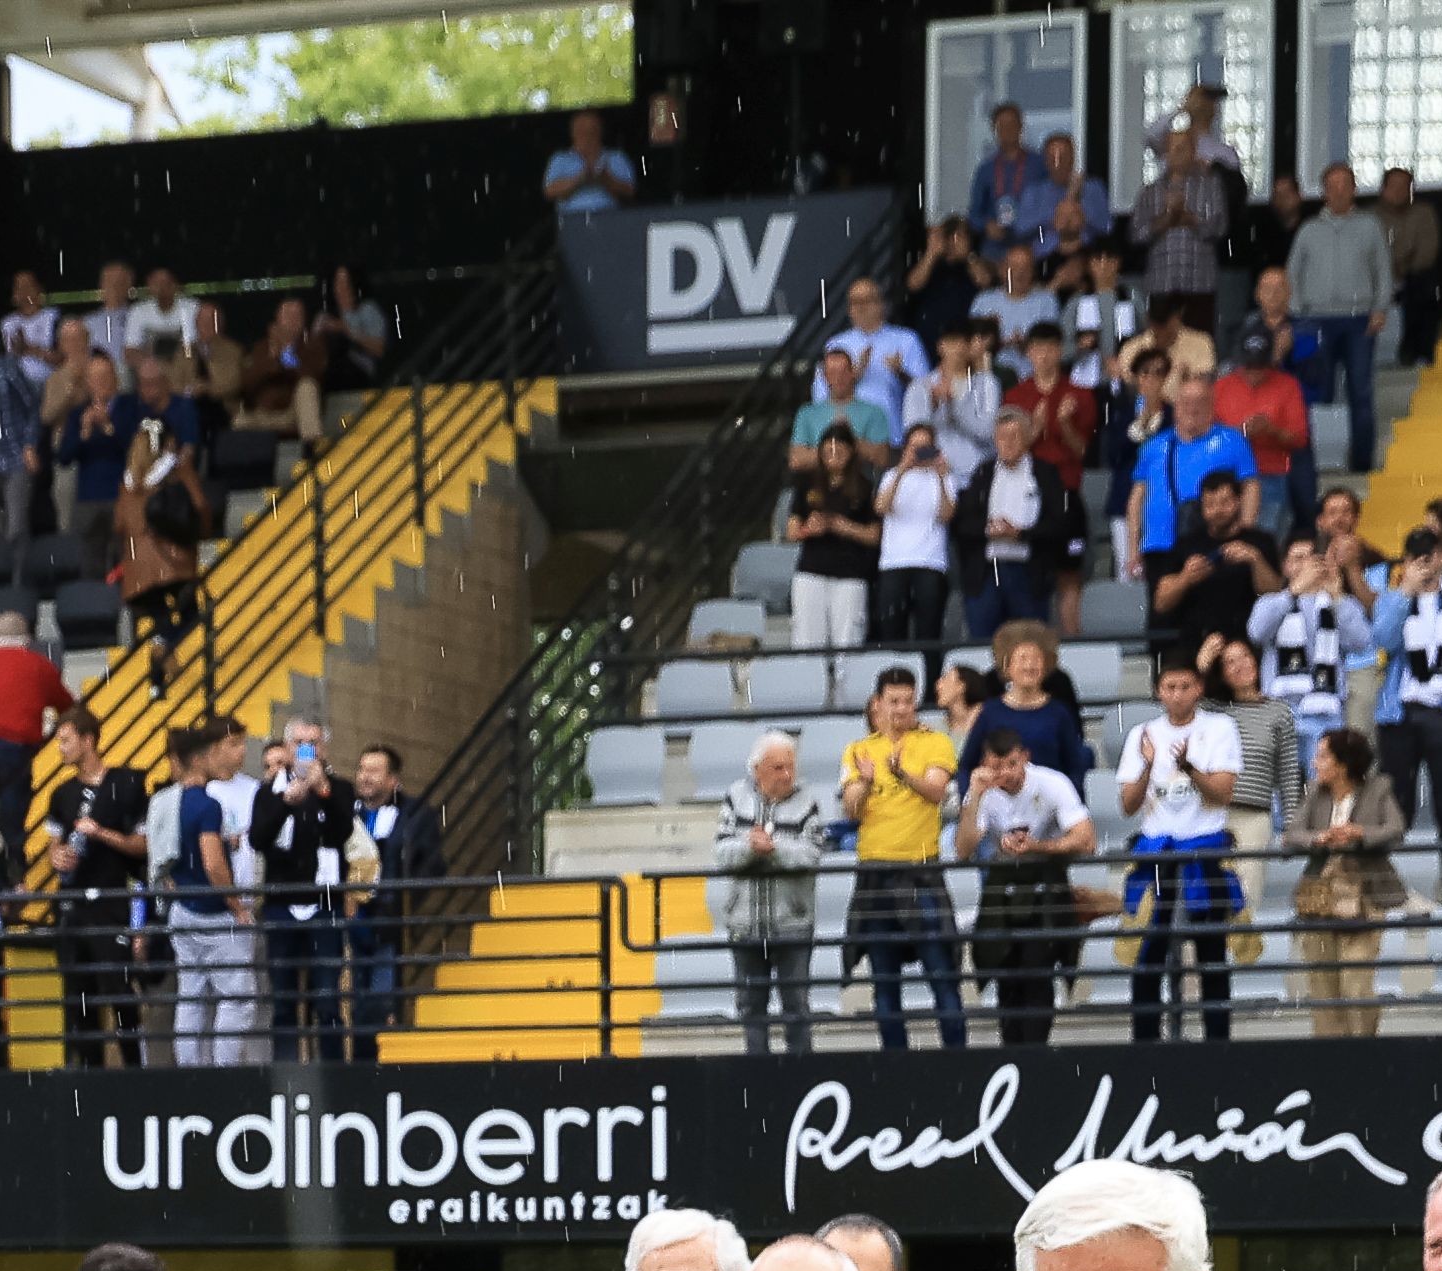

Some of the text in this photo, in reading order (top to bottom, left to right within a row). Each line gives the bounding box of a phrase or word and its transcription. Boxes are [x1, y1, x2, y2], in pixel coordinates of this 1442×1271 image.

[647, 214, 796, 319] DV
[102, 1085, 668, 1190] urdinberri
[785, 1063, 1036, 1213] Real
[1054, 1074, 1408, 1184] Unión
[388, 1188, 669, 1224] eraikuntzak
